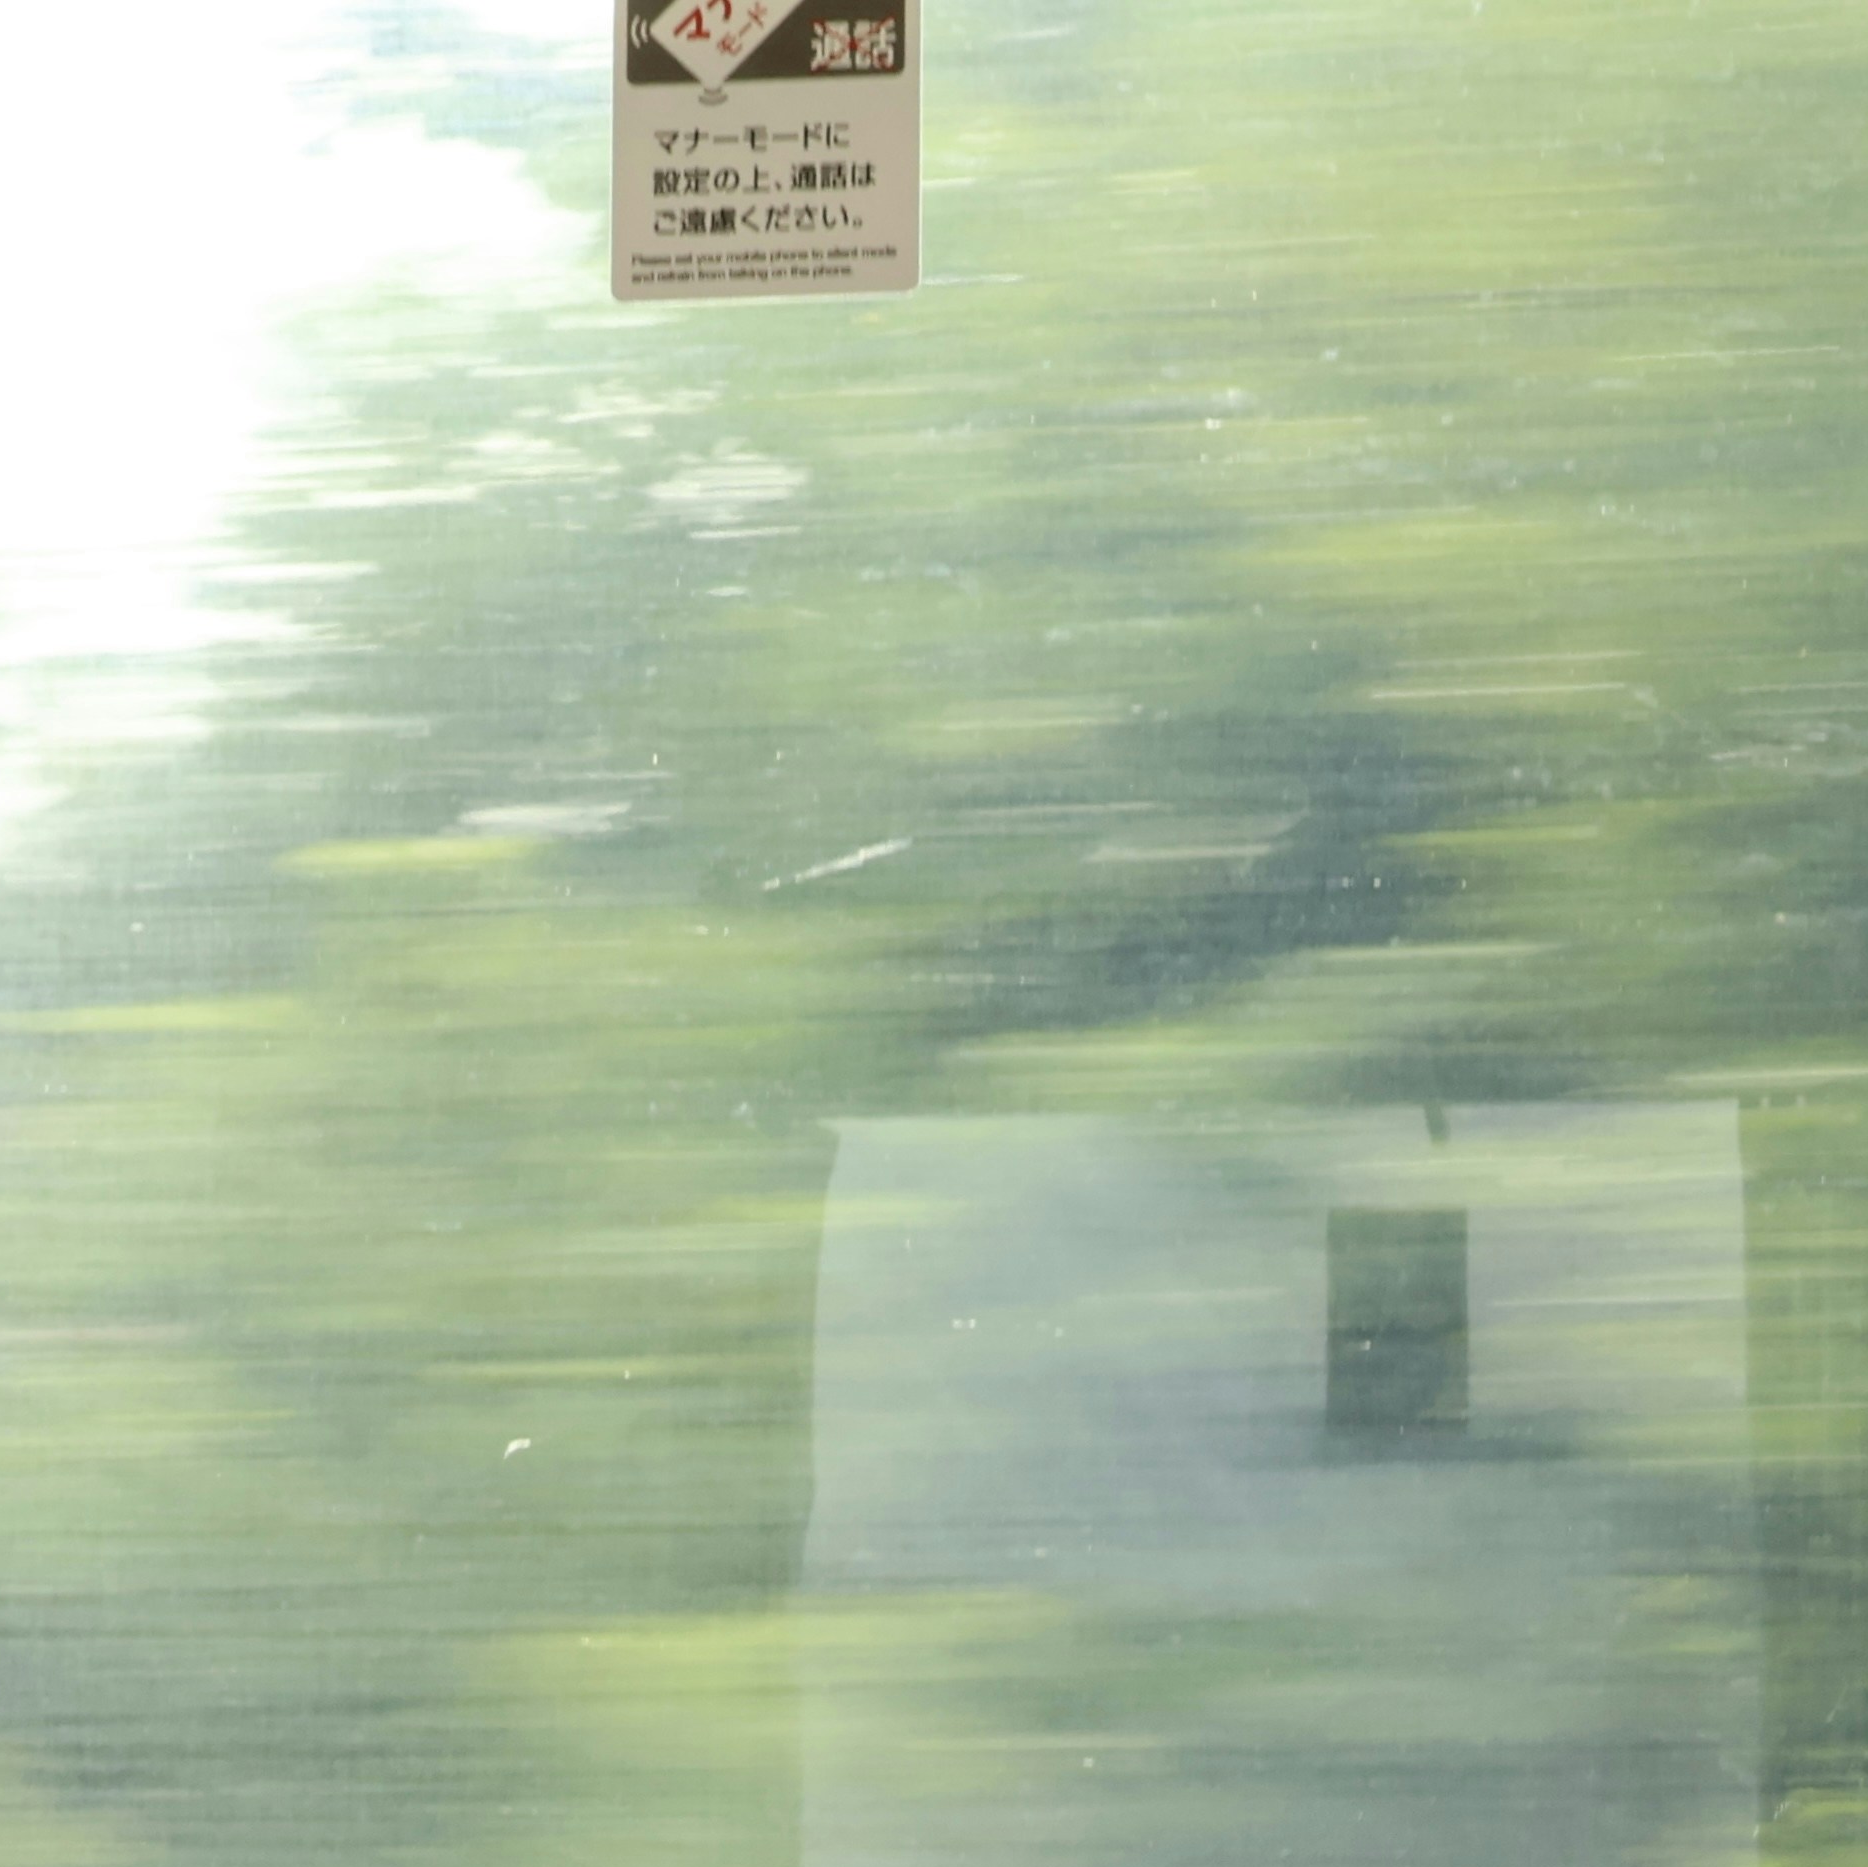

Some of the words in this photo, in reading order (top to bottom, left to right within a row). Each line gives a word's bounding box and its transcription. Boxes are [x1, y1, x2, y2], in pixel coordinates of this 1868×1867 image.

[811, 17, 897, 72] 通話
[654, 122, 850, 155] マナーモードに
[653, 161, 876, 197] 設定の上、通話は
[653, 203, 863, 236] ご遠慮ください。
